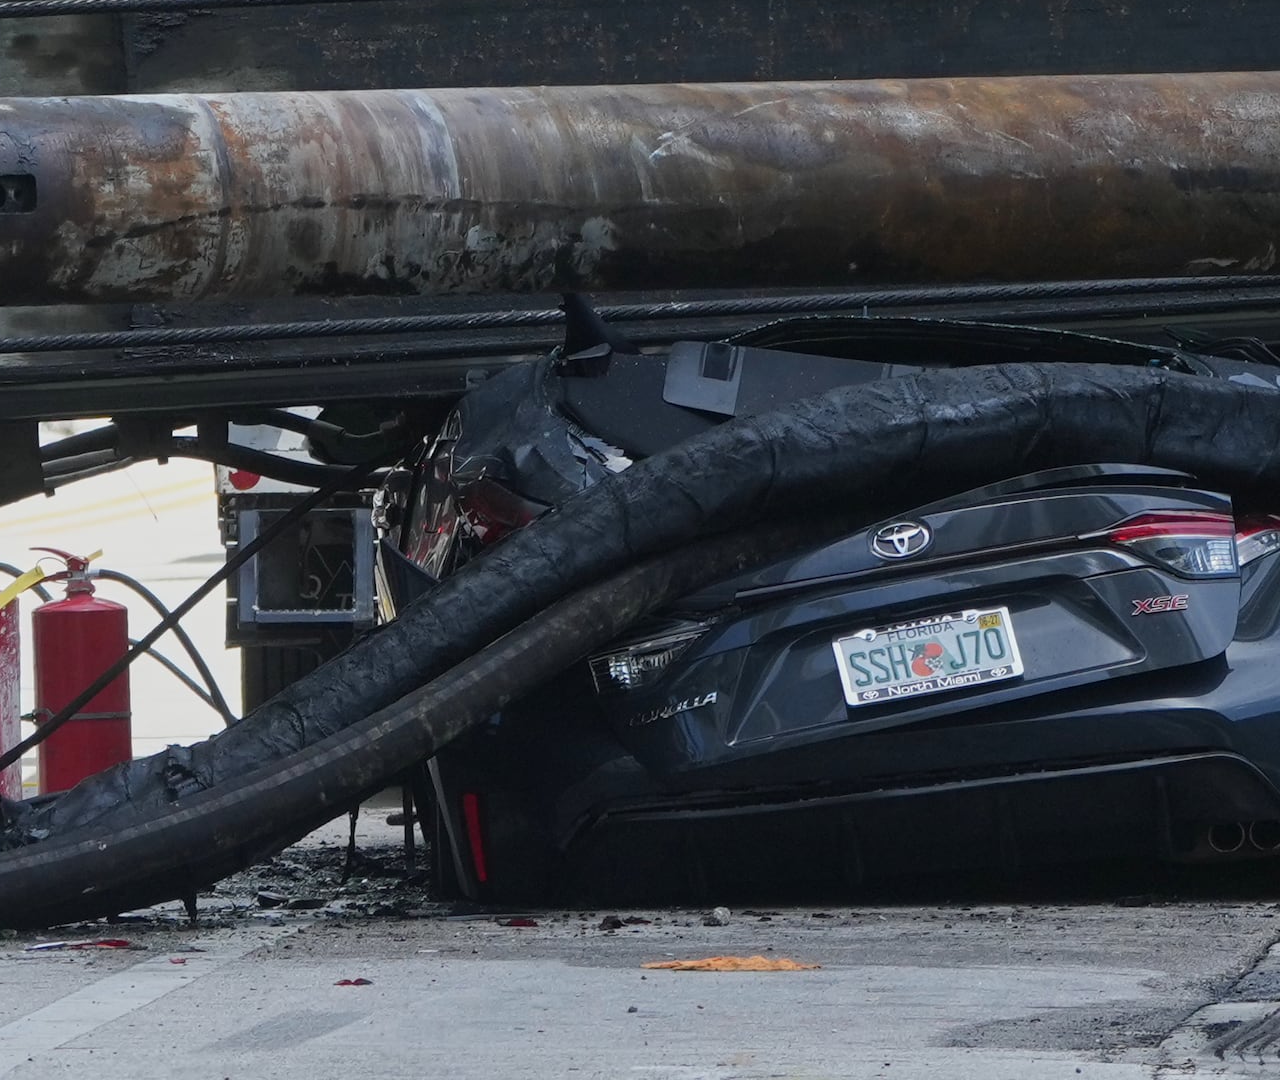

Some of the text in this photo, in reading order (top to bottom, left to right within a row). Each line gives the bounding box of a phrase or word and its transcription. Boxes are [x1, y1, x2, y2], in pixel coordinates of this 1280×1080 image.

[1131, 594, 1189, 616] XSE
[887, 622, 955, 643] FLORIDA
[849, 627, 1006, 687] SSH J70
[888, 680, 933, 697] North
[937, 671, 982, 688] Miami
